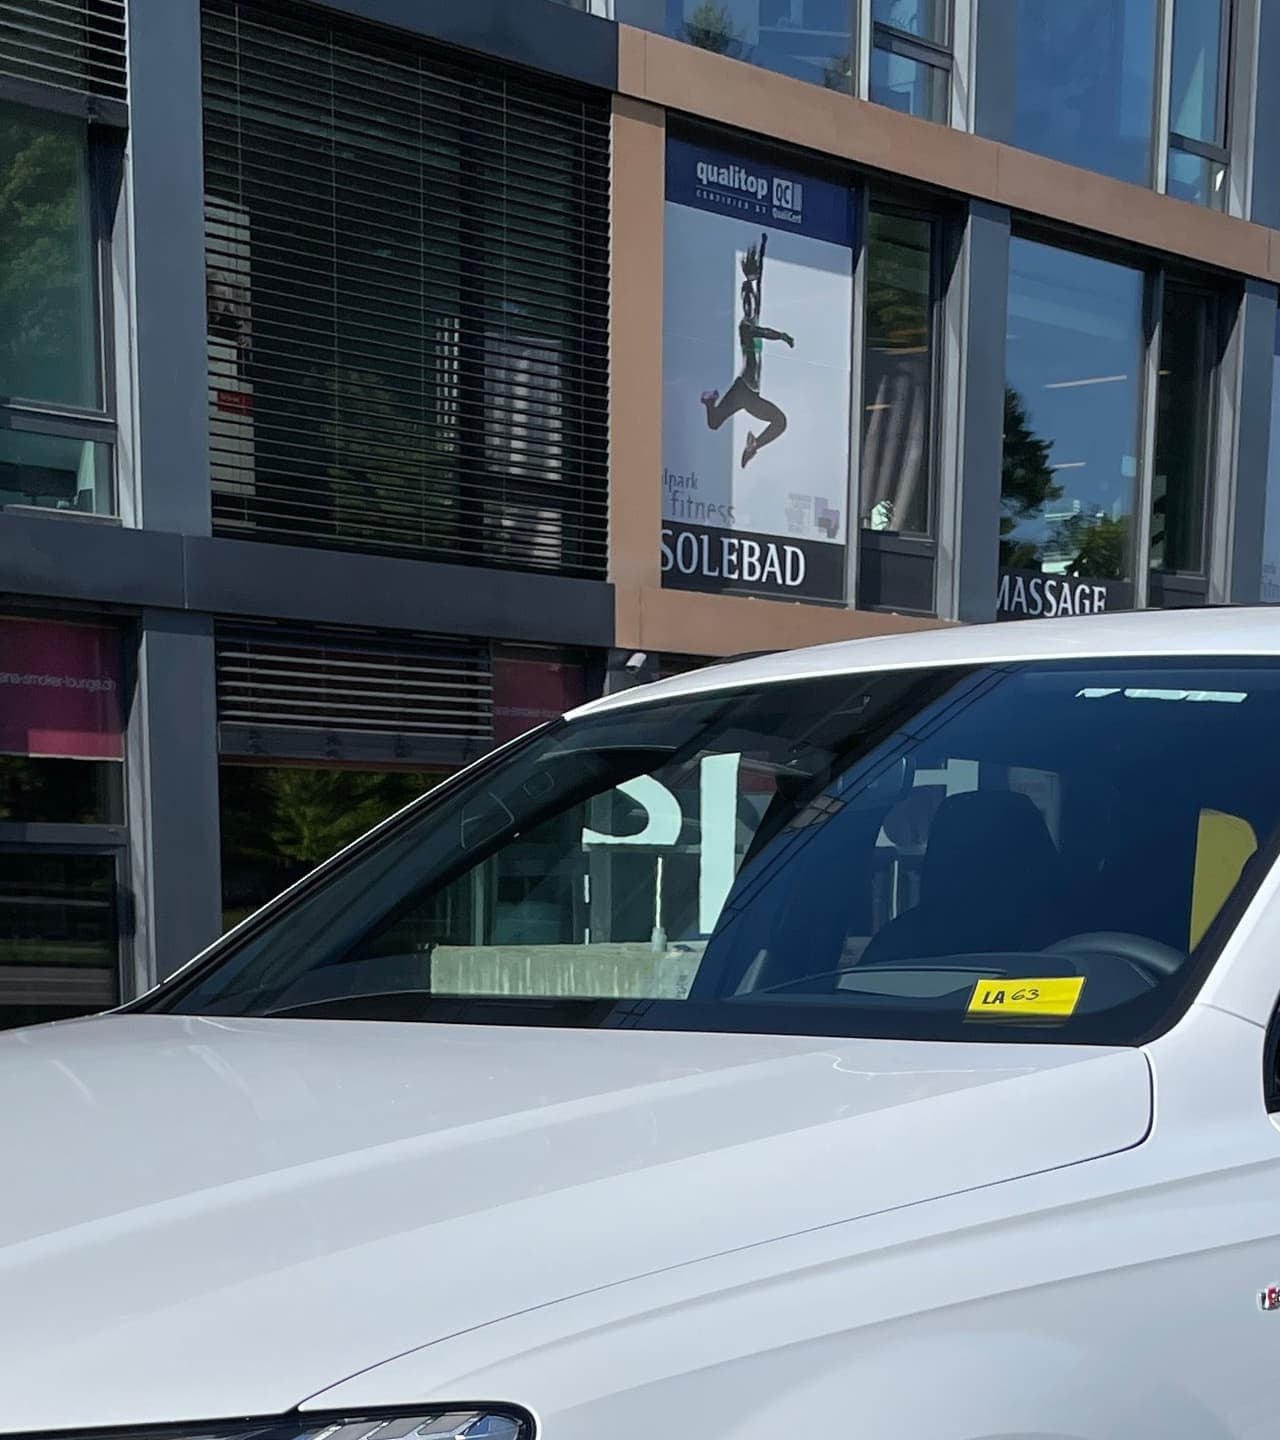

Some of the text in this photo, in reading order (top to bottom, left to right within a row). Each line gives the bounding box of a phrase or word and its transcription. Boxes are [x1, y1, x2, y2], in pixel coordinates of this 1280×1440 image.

[696, 161, 769, 199] qualitop
[670, 489, 737, 528] fitness
[661, 529, 806, 587] SOLEBAD
[982, 988, 1040, 1004] LA 63
